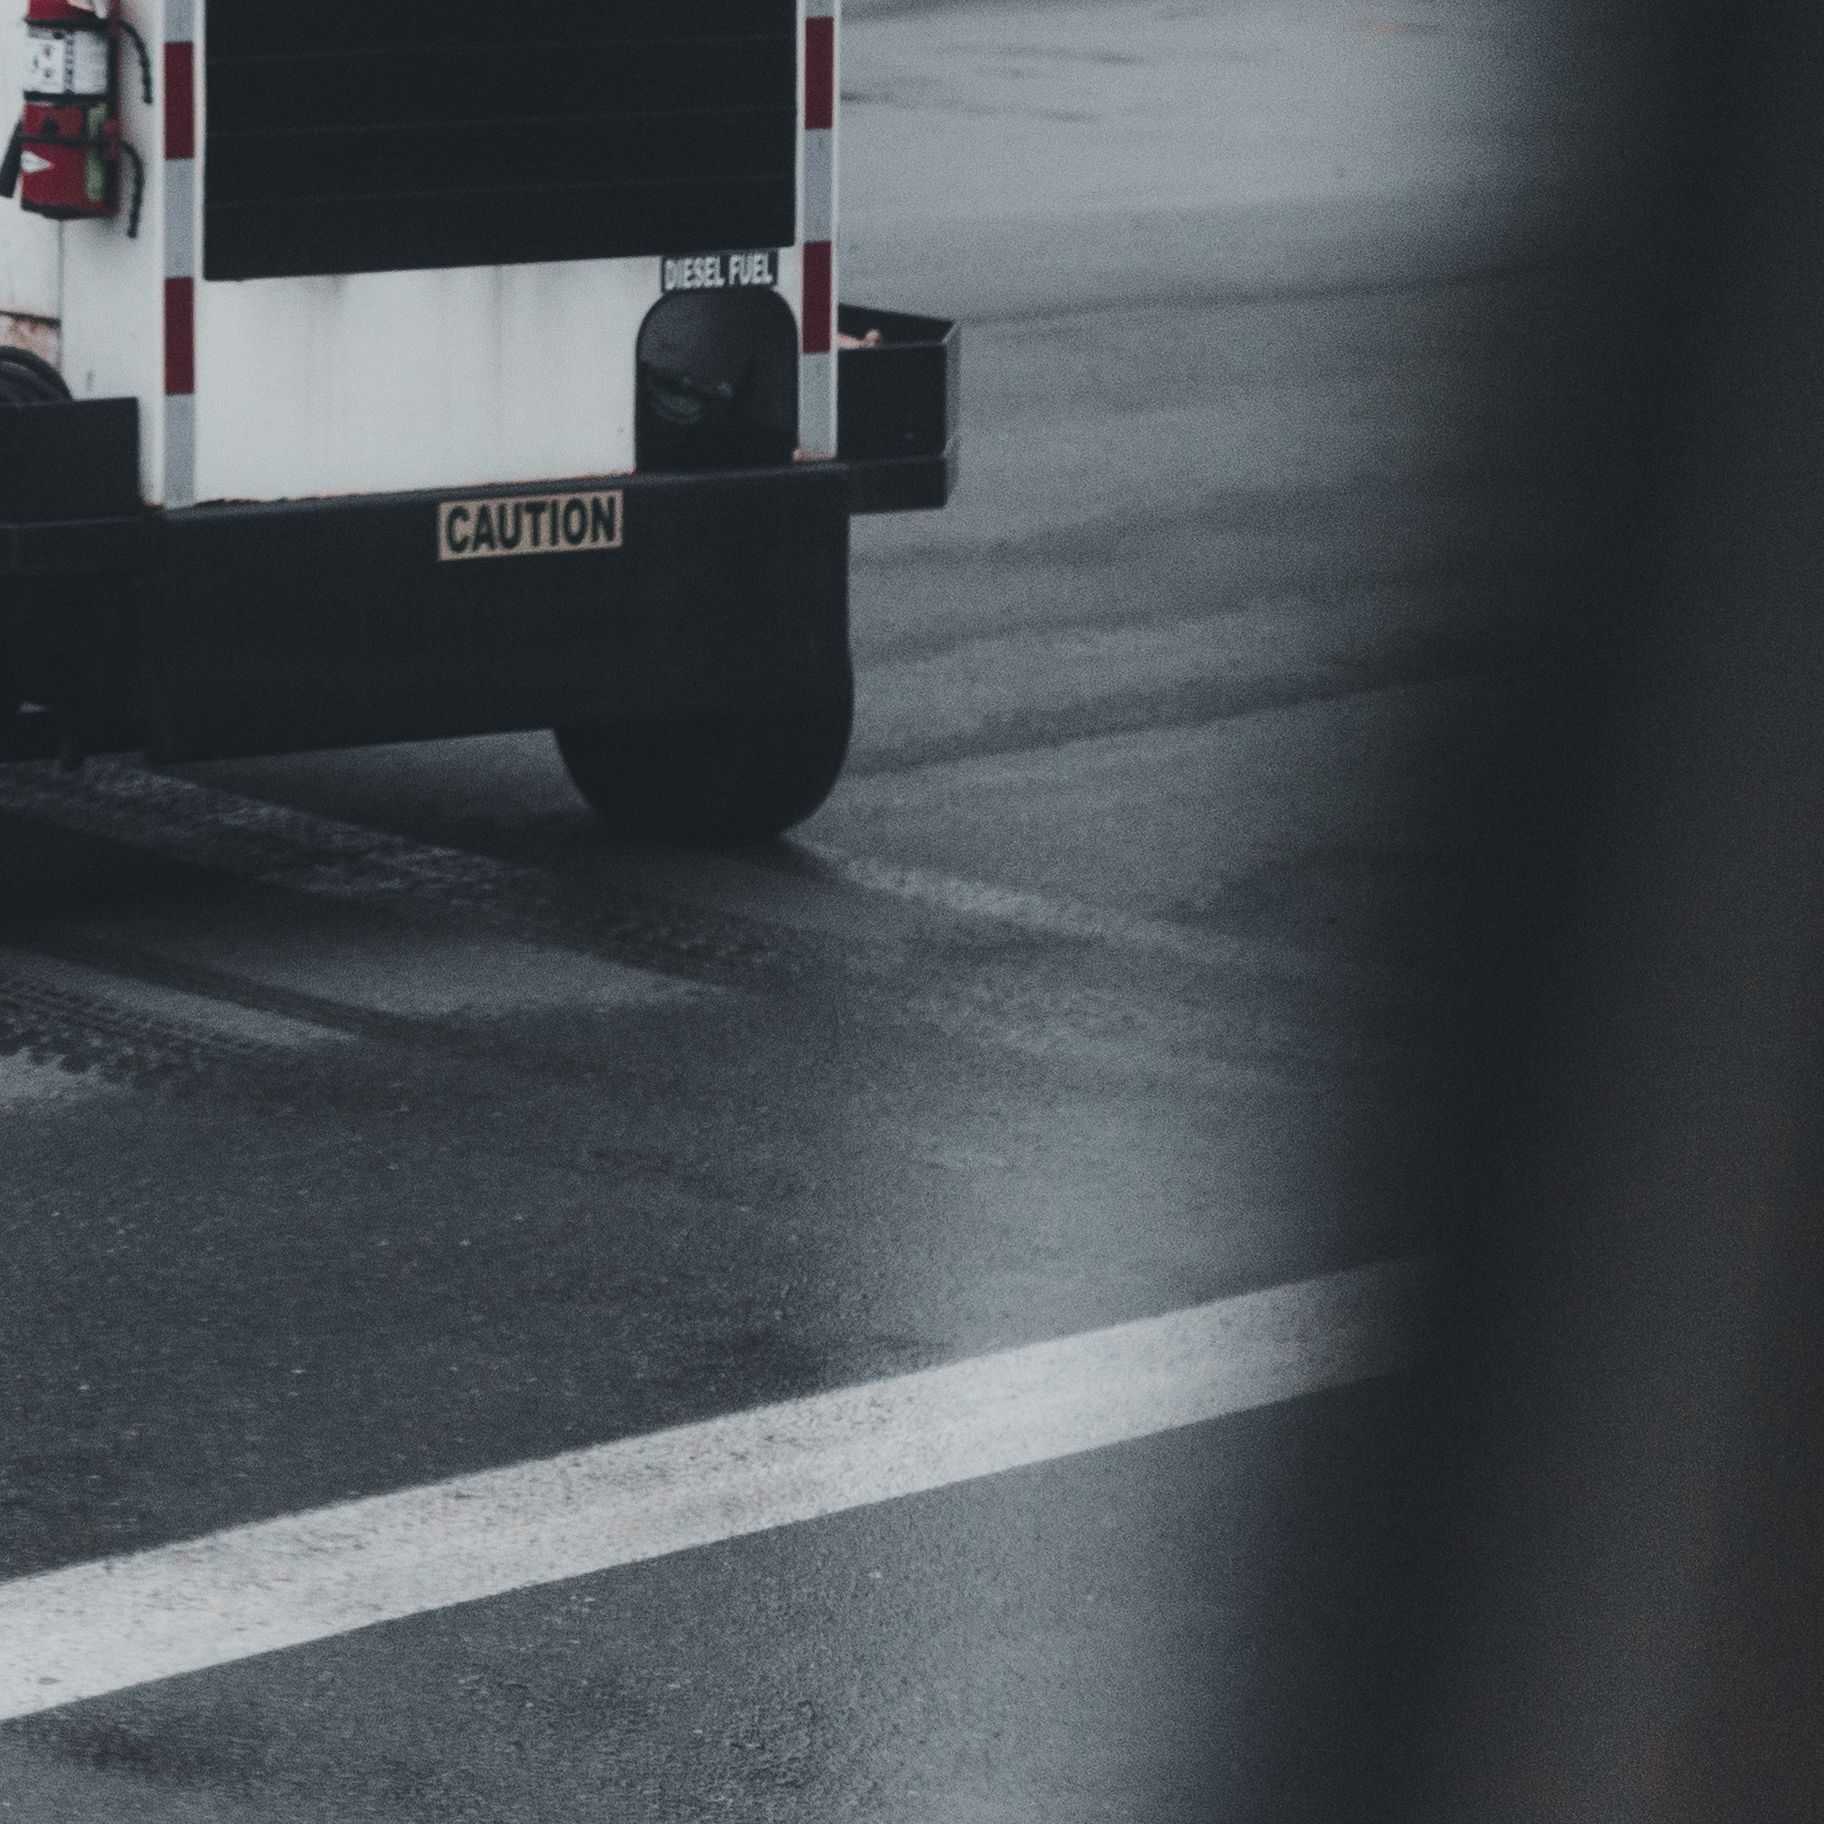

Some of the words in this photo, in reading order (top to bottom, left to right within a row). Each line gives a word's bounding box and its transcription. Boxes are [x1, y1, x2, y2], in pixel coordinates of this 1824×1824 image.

[664, 255, 725, 290] DIESEL
[728, 252, 773, 285] FUEL
[446, 495, 617, 553] CAUTION
